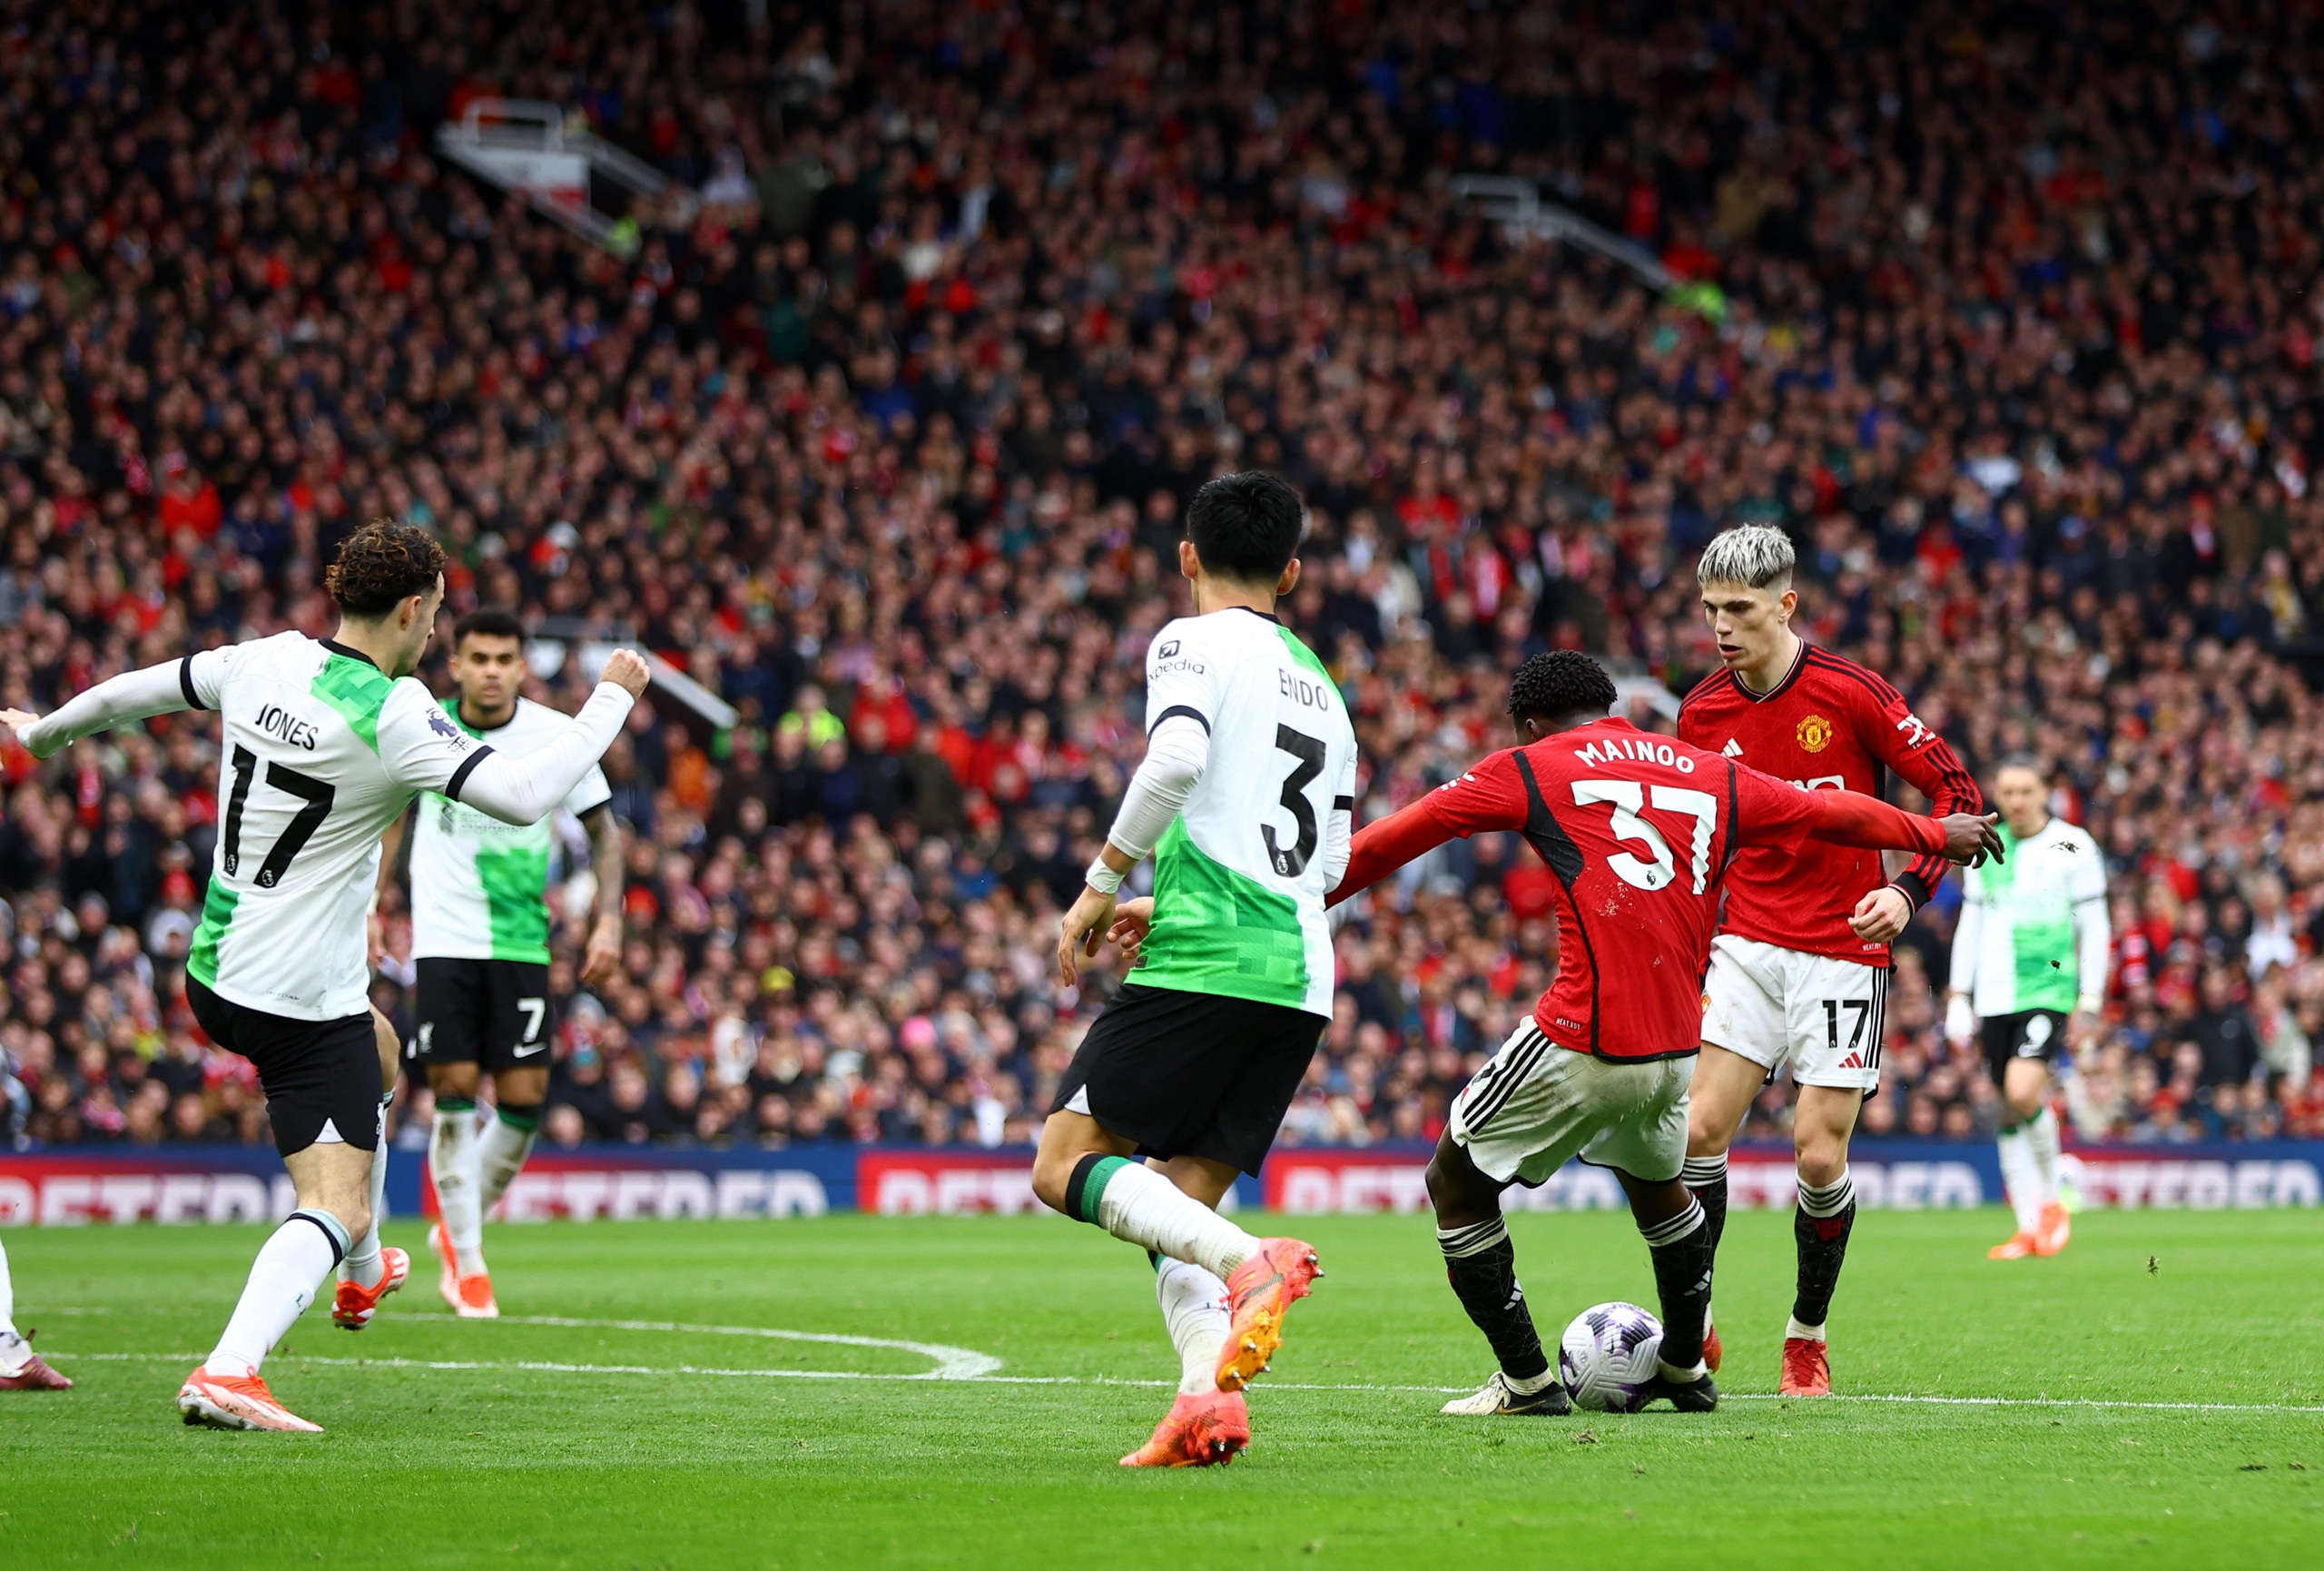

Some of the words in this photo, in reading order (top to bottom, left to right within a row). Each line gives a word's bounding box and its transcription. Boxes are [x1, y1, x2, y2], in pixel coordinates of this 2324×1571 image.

[1278, 667, 1328, 711] ENDO
[255, 703, 320, 752] JONES
[1574, 739, 1696, 775] MAINOO
[223, 744, 335, 888] 17
[1260, 723, 1326, 878] 3
[1570, 779, 1718, 895] 37
[517, 998, 545, 1042] 7
[1822, 1000, 1870, 1048] 17
